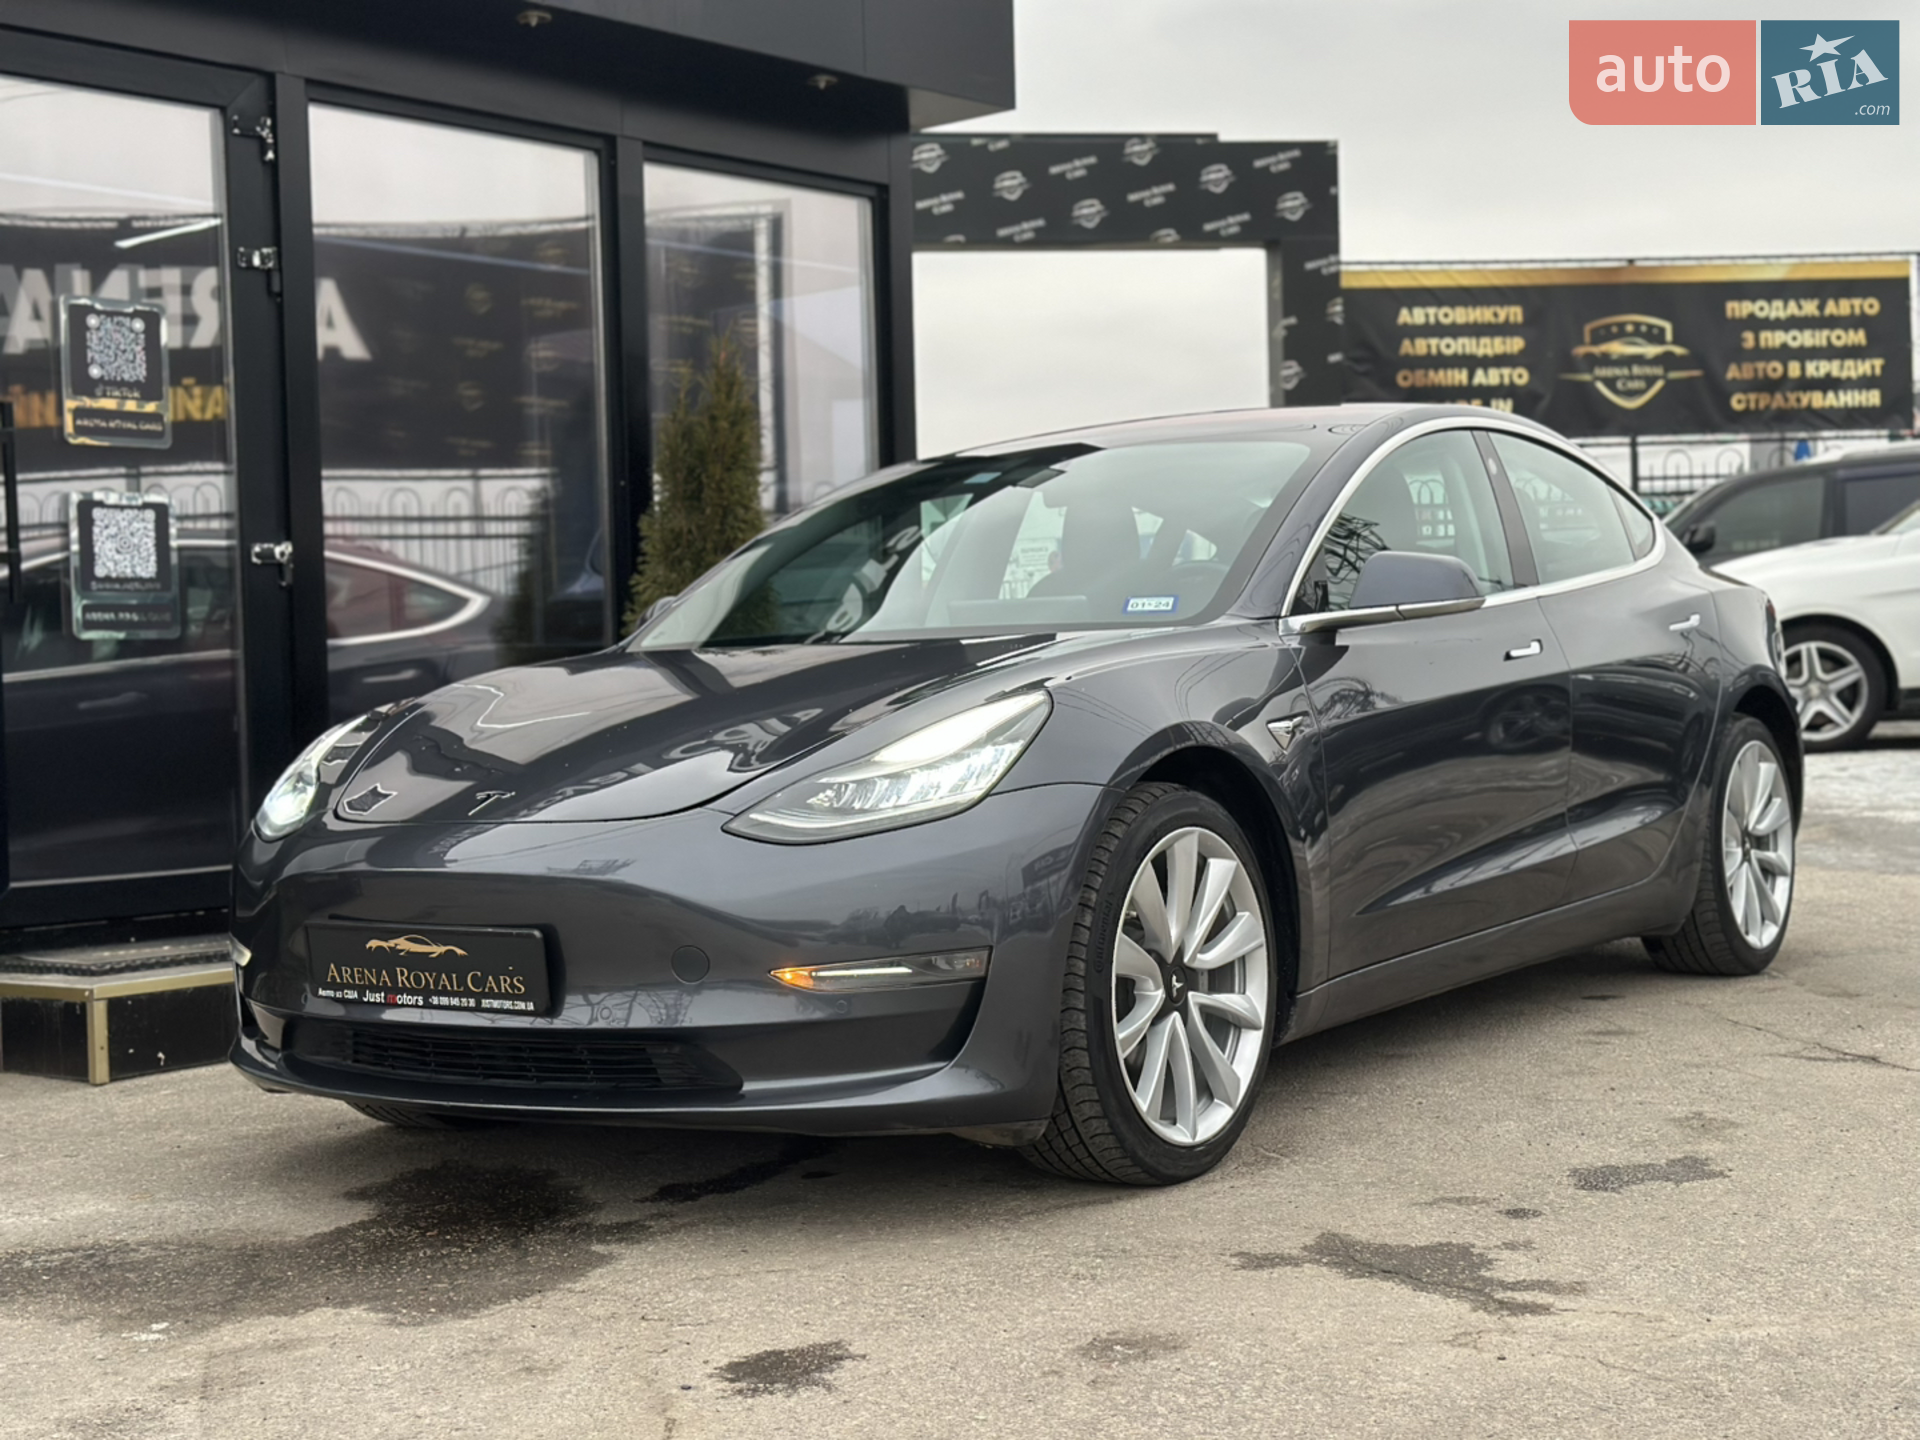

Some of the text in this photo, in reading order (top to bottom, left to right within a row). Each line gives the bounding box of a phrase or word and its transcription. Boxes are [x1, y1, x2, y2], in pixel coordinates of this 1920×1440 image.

[1396, 305, 1524, 326] АВТОВИКУП
[1725, 296, 1881, 321] ПРОДАЖ АВТО
[1399, 335, 1526, 357] АВТОПІДБІР
[1740, 328, 1868, 350] З ПРОБІГОМ
[1396, 366, 1530, 388] ОБМІН АВТО
[1725, 358, 1885, 381] АВТО В КРЕДИТ
[1729, 388, 1882, 411] СТРАХУВАННЯ
[326, 962, 526, 995] ARENA ROYAL CARS
